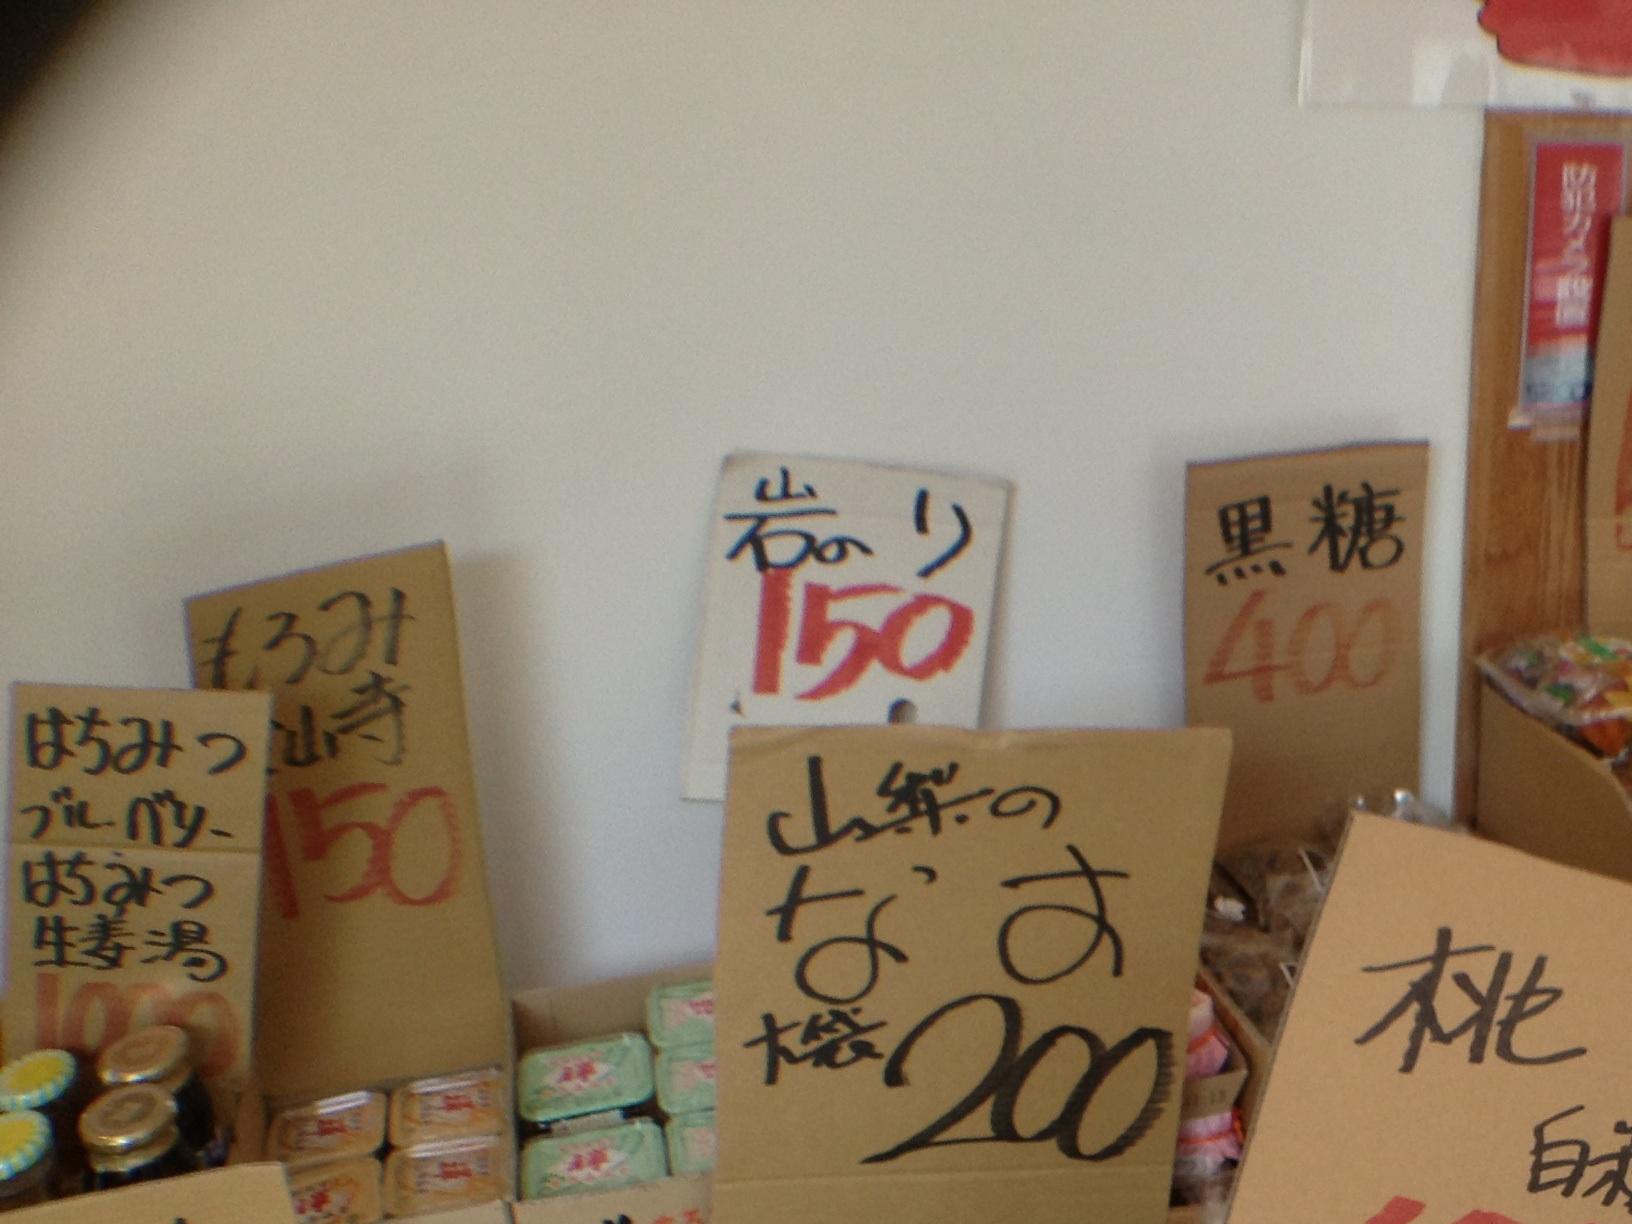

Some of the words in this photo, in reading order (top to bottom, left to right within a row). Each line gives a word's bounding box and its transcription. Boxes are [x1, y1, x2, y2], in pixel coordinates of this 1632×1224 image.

[723, 466, 973, 578] 岩のり
[1205, 481, 1408, 586] 黒糖
[752, 566, 975, 700] 150
[1203, 588, 1397, 703] 400
[26, 706, 247, 775] はちみつ
[266, 670, 411, 774] 山寺
[767, 755, 1061, 855] 山梨の
[22, 851, 215, 908] はちみつ
[765, 844, 1130, 1005] なす
[1352, 926, 1588, 1074] 桃
[859, 992, 1174, 1166] 200
